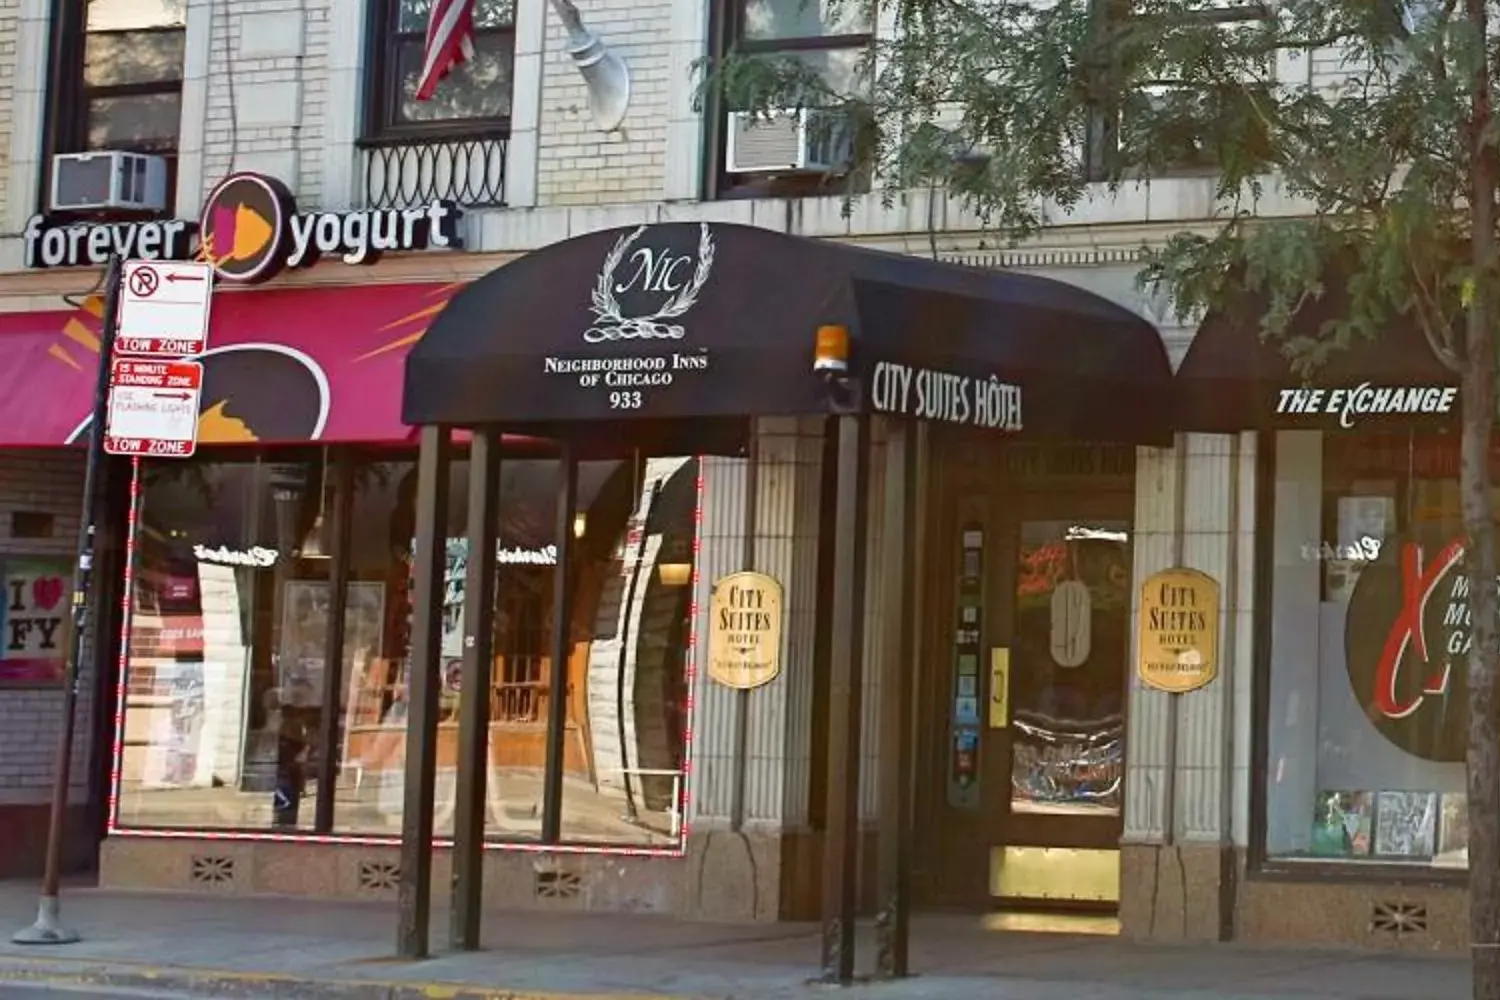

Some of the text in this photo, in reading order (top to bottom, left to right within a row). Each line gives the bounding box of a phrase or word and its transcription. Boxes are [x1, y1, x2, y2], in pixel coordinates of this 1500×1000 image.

[24, 200, 451, 266] forever yogurt
[616, 247, 691, 293] NIC
[123, 340, 197, 353] TOW ZONE
[132, 364, 168, 375] MINUTE
[544, 353, 708, 373] NEIGHBORHOOD INNS
[118, 375, 192, 387] STANDING ZONE
[579, 371, 673, 388] OF CHICAGO
[609, 391, 642, 409] 933
[871, 361, 913, 413] CITY
[915, 368, 970, 424] SUITES
[1276, 381, 1458, 428] THE EXCHANGE
[112, 440, 185, 452] TOW ZONE
[9, 579, 26, 611] I
[728, 585, 765, 609] CITY
[1160, 583, 1197, 607] CITY
[719, 607, 772, 631] SUITES
[1148, 606, 1206, 632] SUITES
[7, 618, 61, 650] FY
